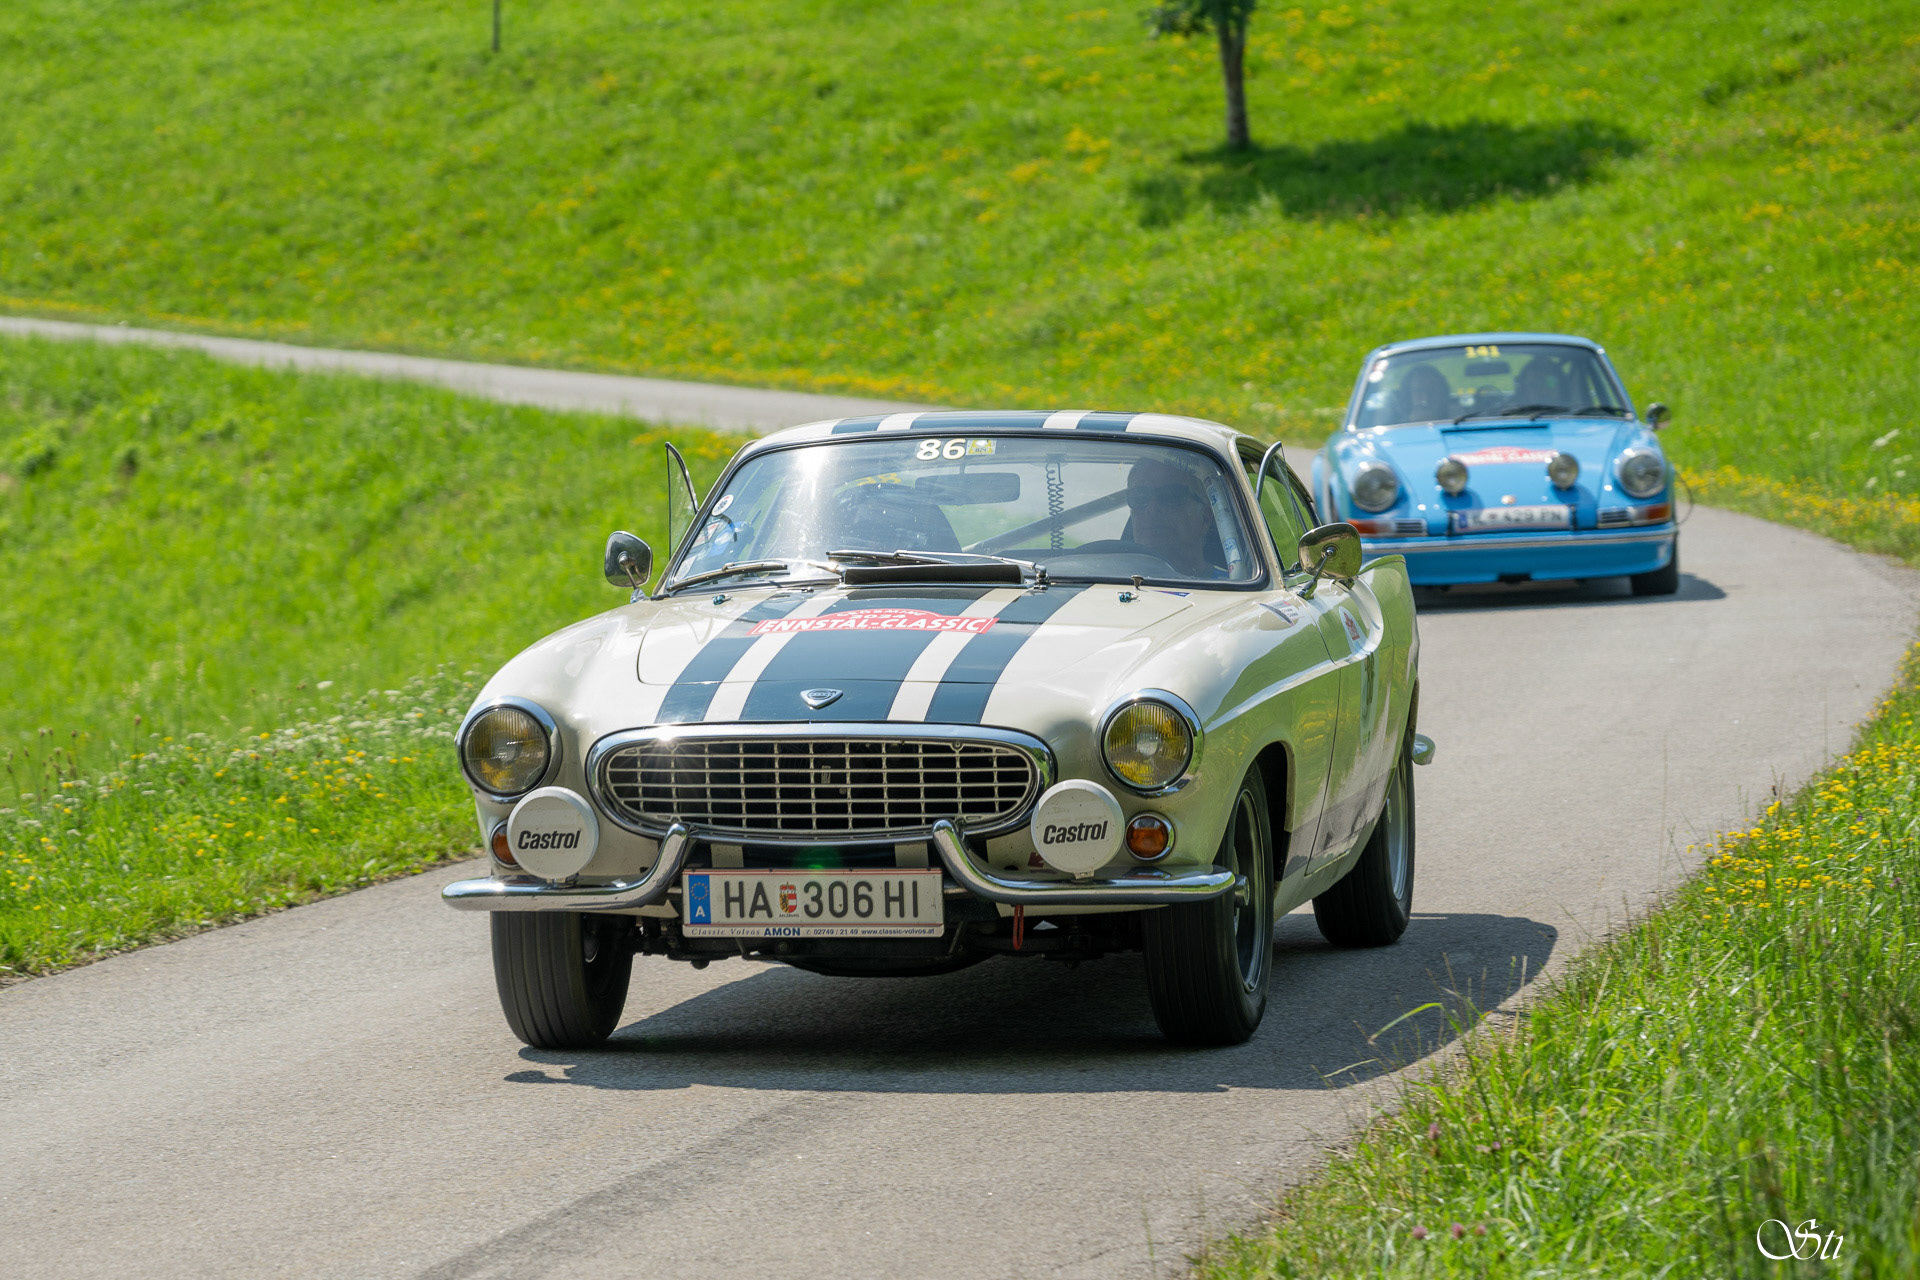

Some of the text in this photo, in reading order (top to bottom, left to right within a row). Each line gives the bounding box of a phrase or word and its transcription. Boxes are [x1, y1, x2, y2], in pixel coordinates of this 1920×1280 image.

[916, 438, 966, 460] 86
[758, 618, 986, 632] ENNSTAL-CLASSIC
[517, 830, 581, 850] Castrol
[1043, 820, 1108, 844] Castrol
[724, 880, 919, 918] HA 306 HI
[695, 905, 706, 918] A
[691, 928, 726, 936] Classic
[730, 928, 760, 936] Volvos
[763, 927, 801, 936] AMON
[861, 927, 935, 936] www.classic-volvos.at
